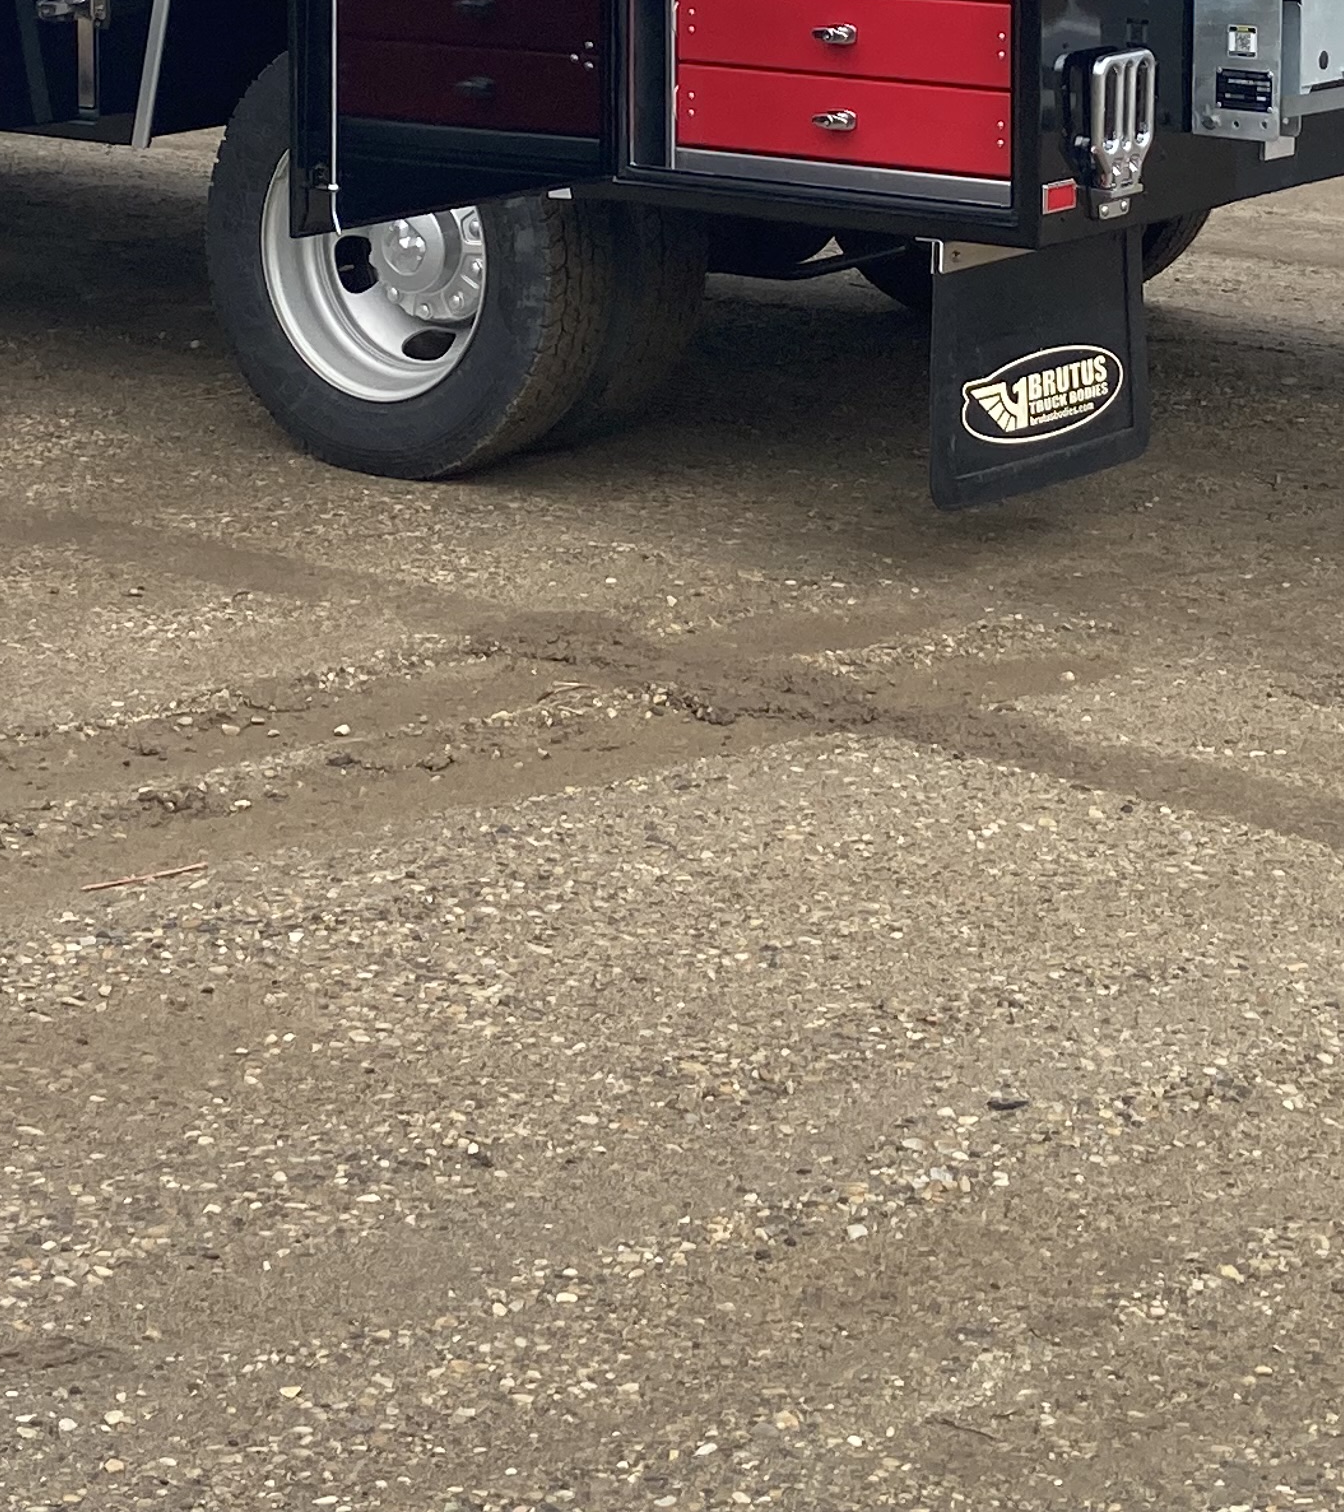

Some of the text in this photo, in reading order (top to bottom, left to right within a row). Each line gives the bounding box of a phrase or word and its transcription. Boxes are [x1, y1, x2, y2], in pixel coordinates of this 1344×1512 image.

[1028, 355, 1108, 400] BRUTUS
[1029, 382, 1108, 414] TRUCK BODIES
